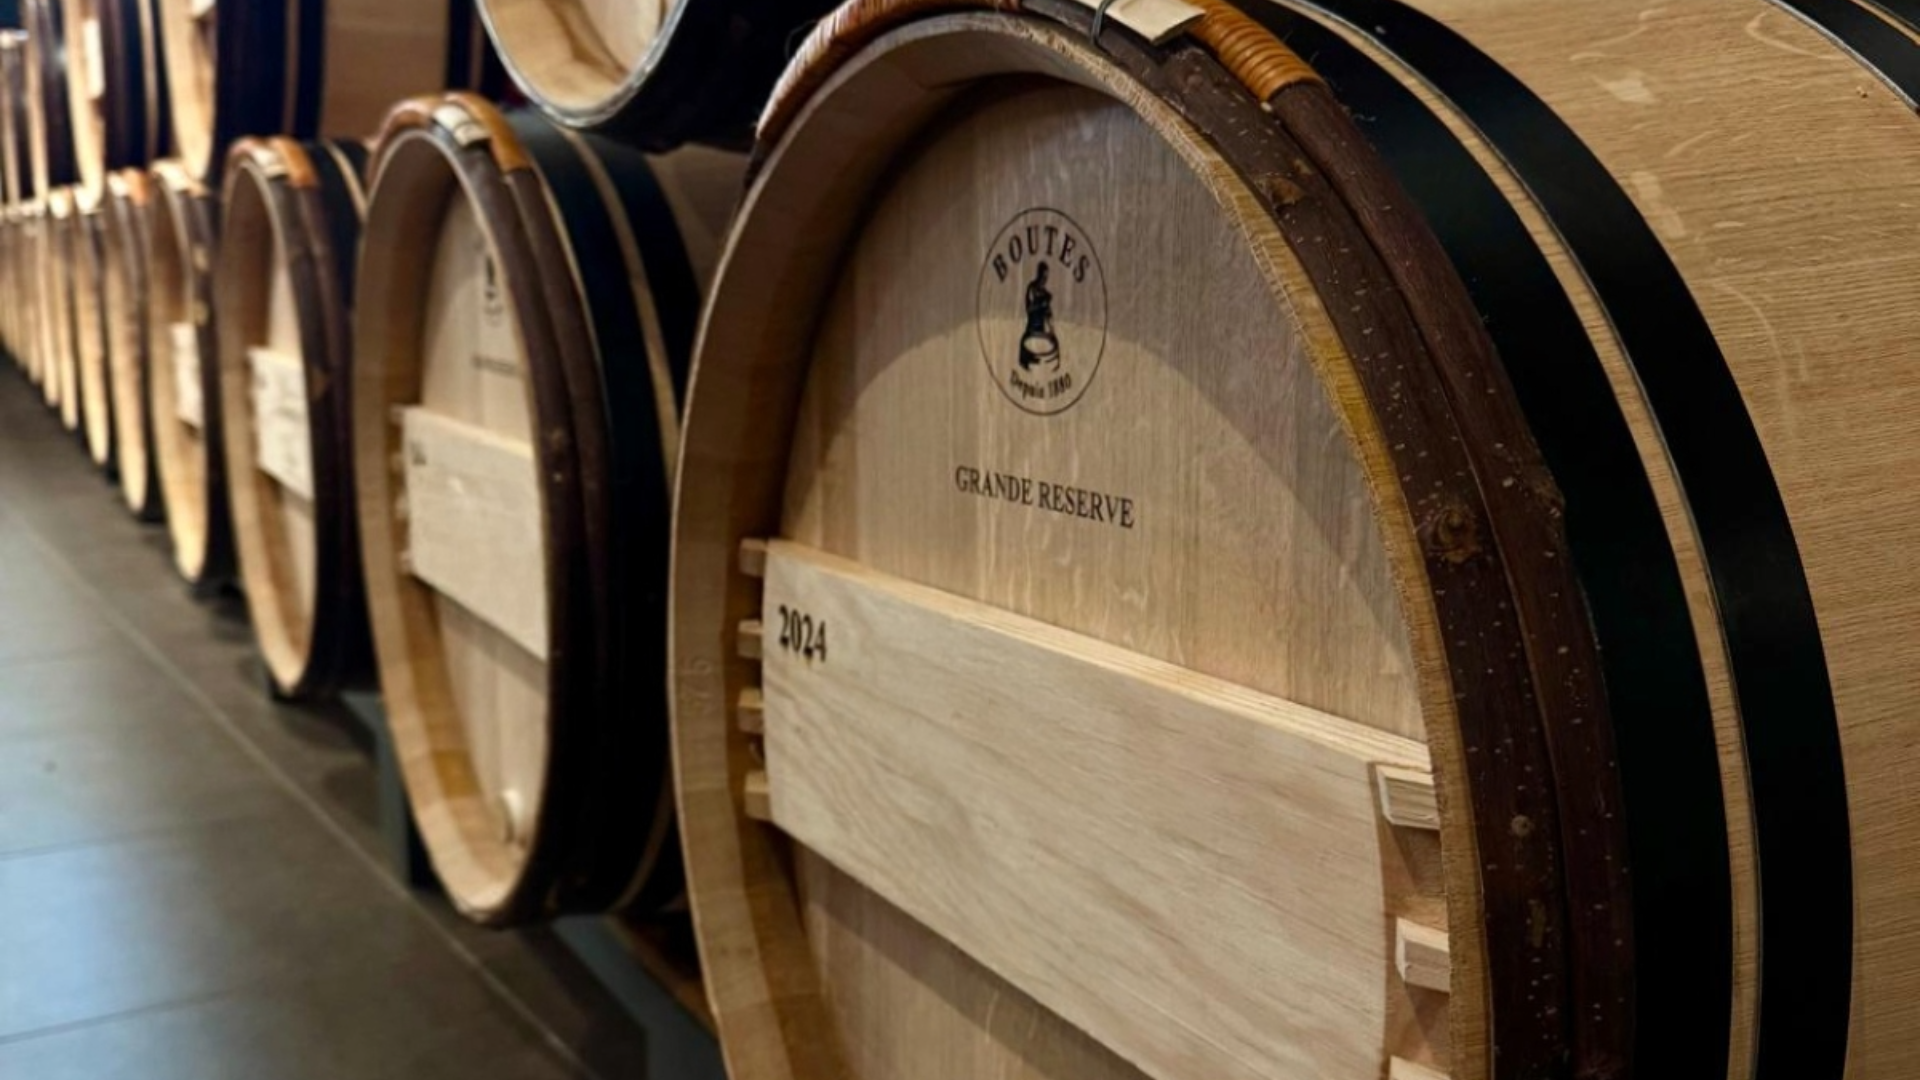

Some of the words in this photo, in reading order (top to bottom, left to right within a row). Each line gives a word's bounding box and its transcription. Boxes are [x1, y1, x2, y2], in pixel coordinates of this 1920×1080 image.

[993, 225, 1090, 283] BOUTES
[1010, 369, 1045, 400] Depuis
[955, 465, 1033, 506] GRANDE
[1038, 481, 1135, 529] RESERVE
[778, 604, 827, 663] 2024
